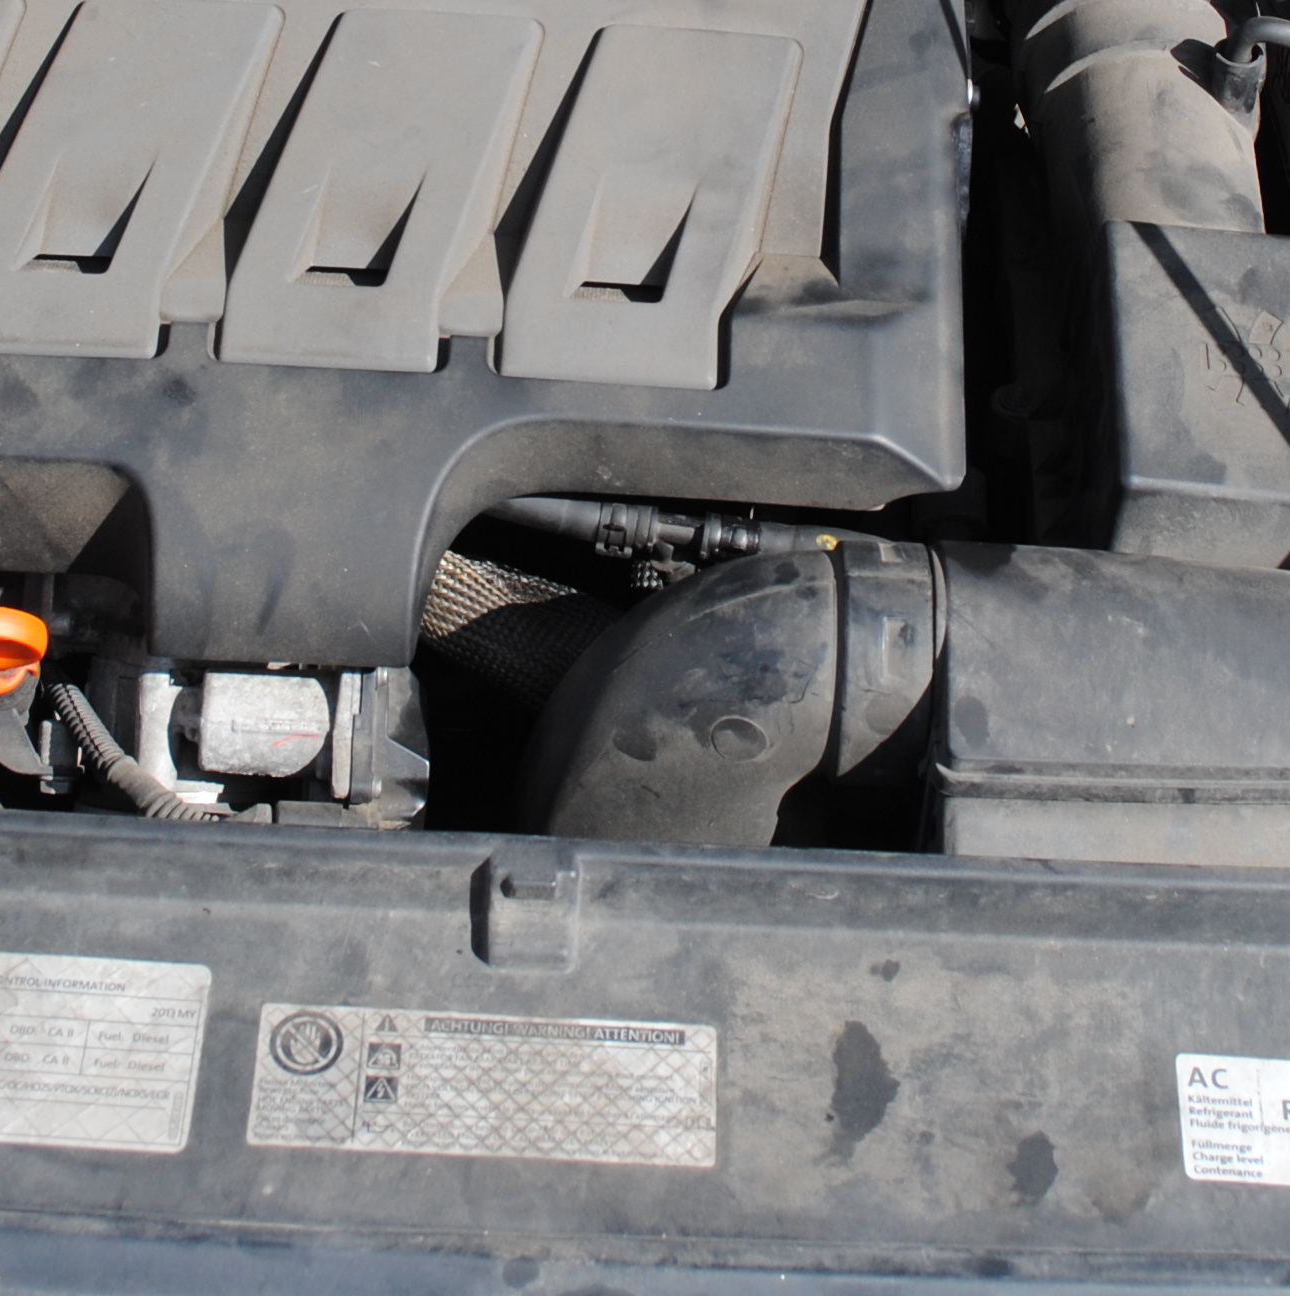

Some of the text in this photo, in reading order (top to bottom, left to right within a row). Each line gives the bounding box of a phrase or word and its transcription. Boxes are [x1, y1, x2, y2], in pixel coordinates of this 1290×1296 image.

[43, 978, 126, 992] INFORMATION
[150, 1007, 197, 1020] 2013 MY
[47, 1027, 64, 1037] CA
[131, 1032, 170, 1045] Diesel
[430, 1018, 680, 1044] ACHTUNG! WARNING! ATTENTION!
[42, 1054, 59, 1064] CA
[126, 1059, 166, 1072] Diesel
[1187, 1066, 1229, 1090] AC
[1187, 1094, 1253, 1108] Kältemittel
[1188, 1106, 1254, 1120] Refrigerant
[1189, 1118, 1225, 1130] Fluide
[1191, 1139, 1253, 1153] Füllmenge
[1192, 1152, 1264, 1165] Charge level
[1193, 1165, 1264, 1179] Contenance
